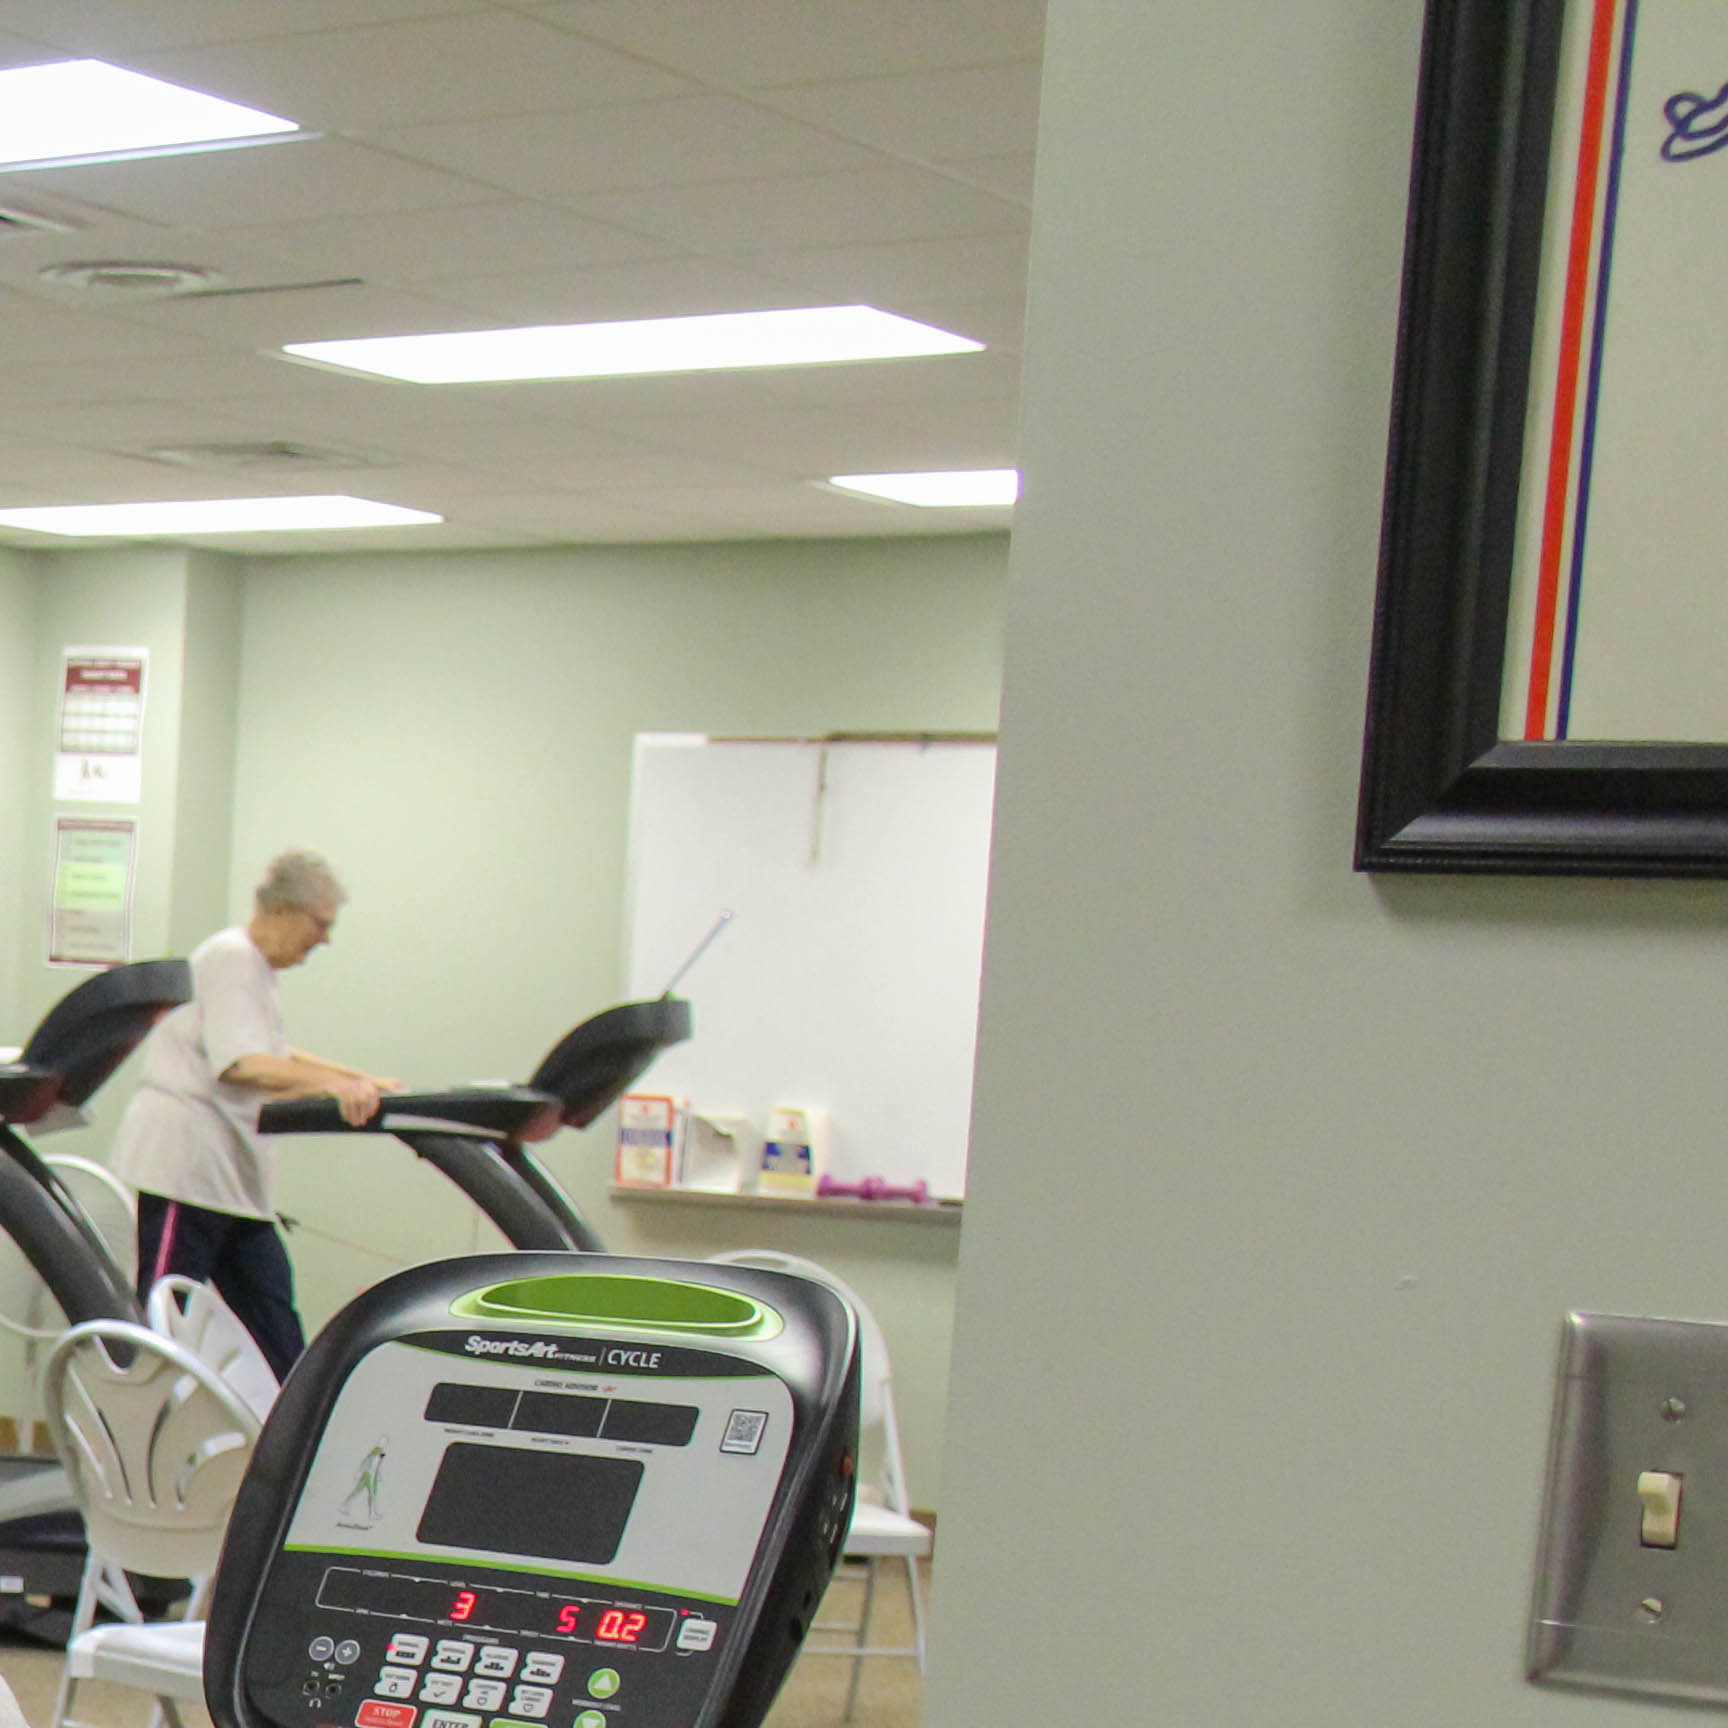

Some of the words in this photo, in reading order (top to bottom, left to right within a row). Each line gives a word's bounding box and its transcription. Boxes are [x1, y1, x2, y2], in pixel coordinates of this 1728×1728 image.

[465, 1335, 558, 1359] SportsArt
[607, 1349, 662, 1369] CYCLE
[449, 1591, 478, 1620] 3
[372, 1707, 402, 1718] STOP
